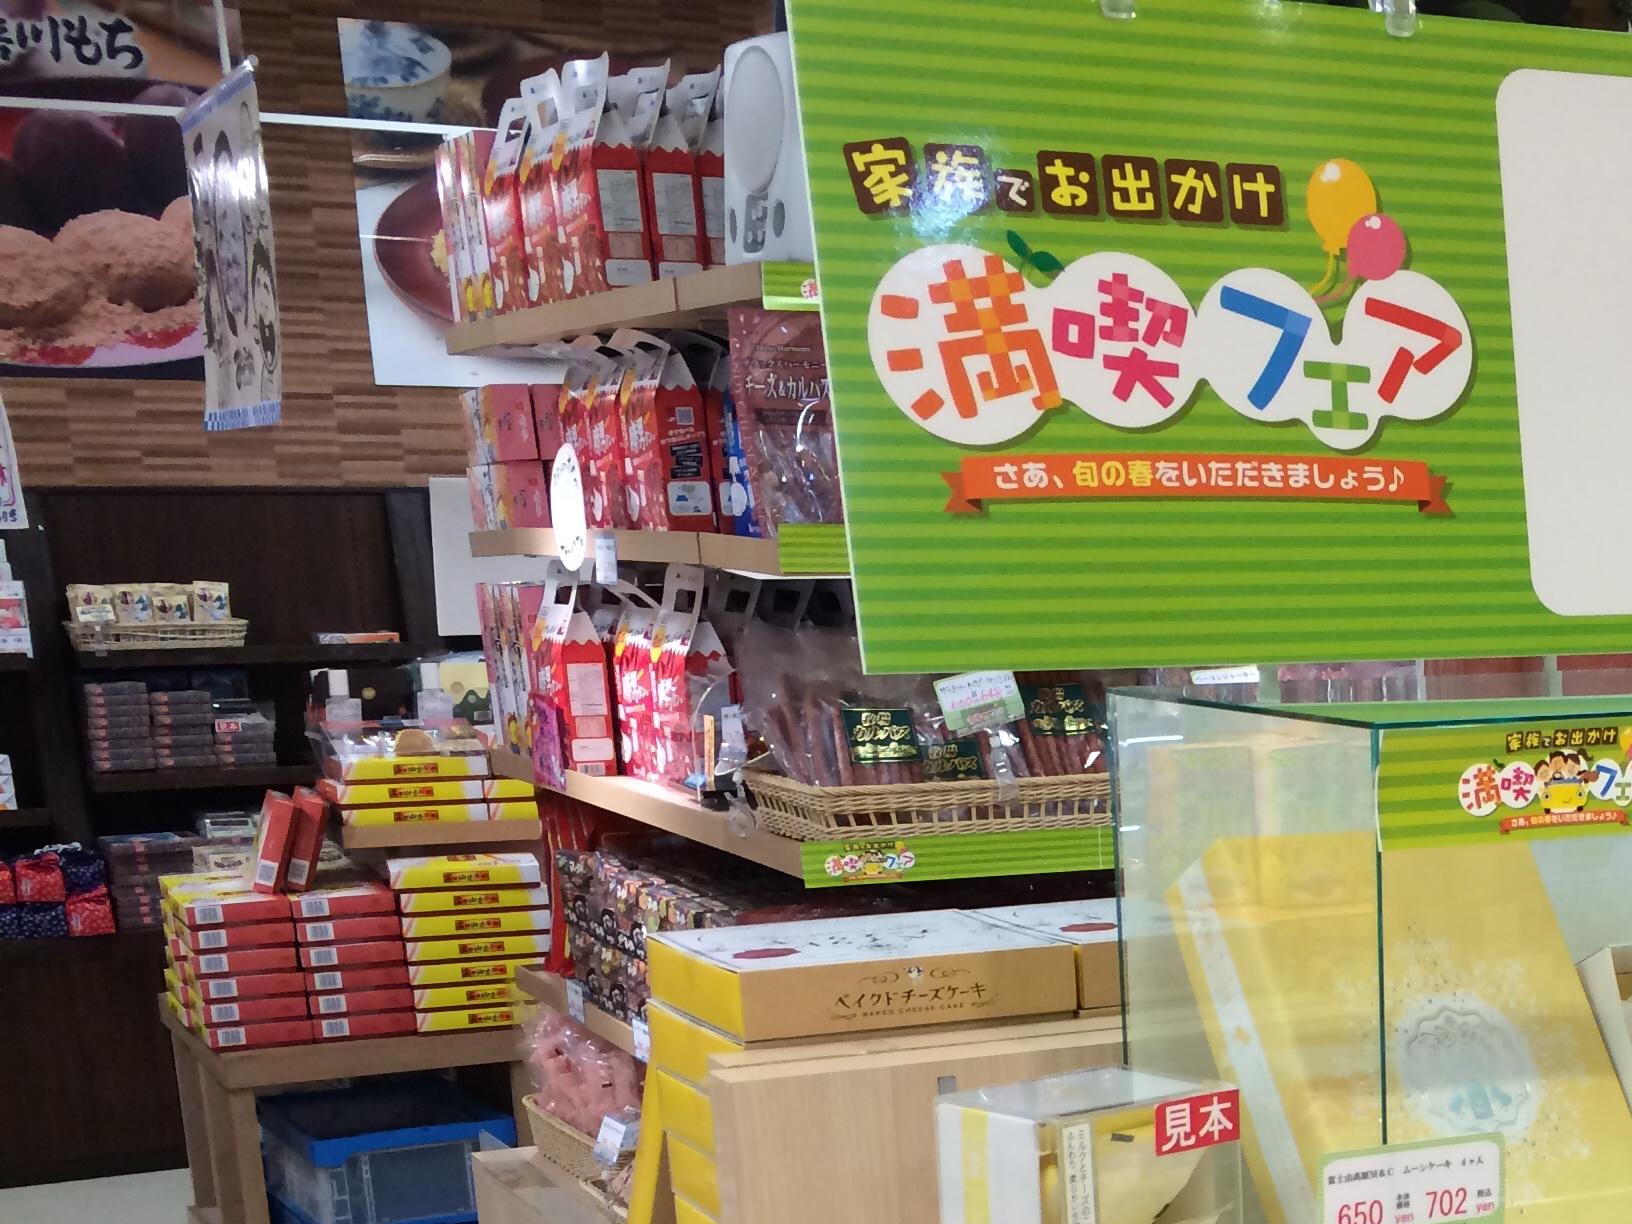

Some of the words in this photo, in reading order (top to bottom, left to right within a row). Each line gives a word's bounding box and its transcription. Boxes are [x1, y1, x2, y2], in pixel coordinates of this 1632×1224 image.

[847, 139, 1279, 222] 家族でお出かけ
[880, 255, 1463, 431] 満喫フェア
[1507, 727, 1617, 752] 家族でお出かけ
[832, 982, 986, 1010] ベイクドチーズケーキ
[1161, 1096, 1234, 1152] 見本
[1394, 1212, 1414, 1224] yen
[1426, 1187, 1467, 1219] 702
[1475, 1202, 1495, 1214] yen
